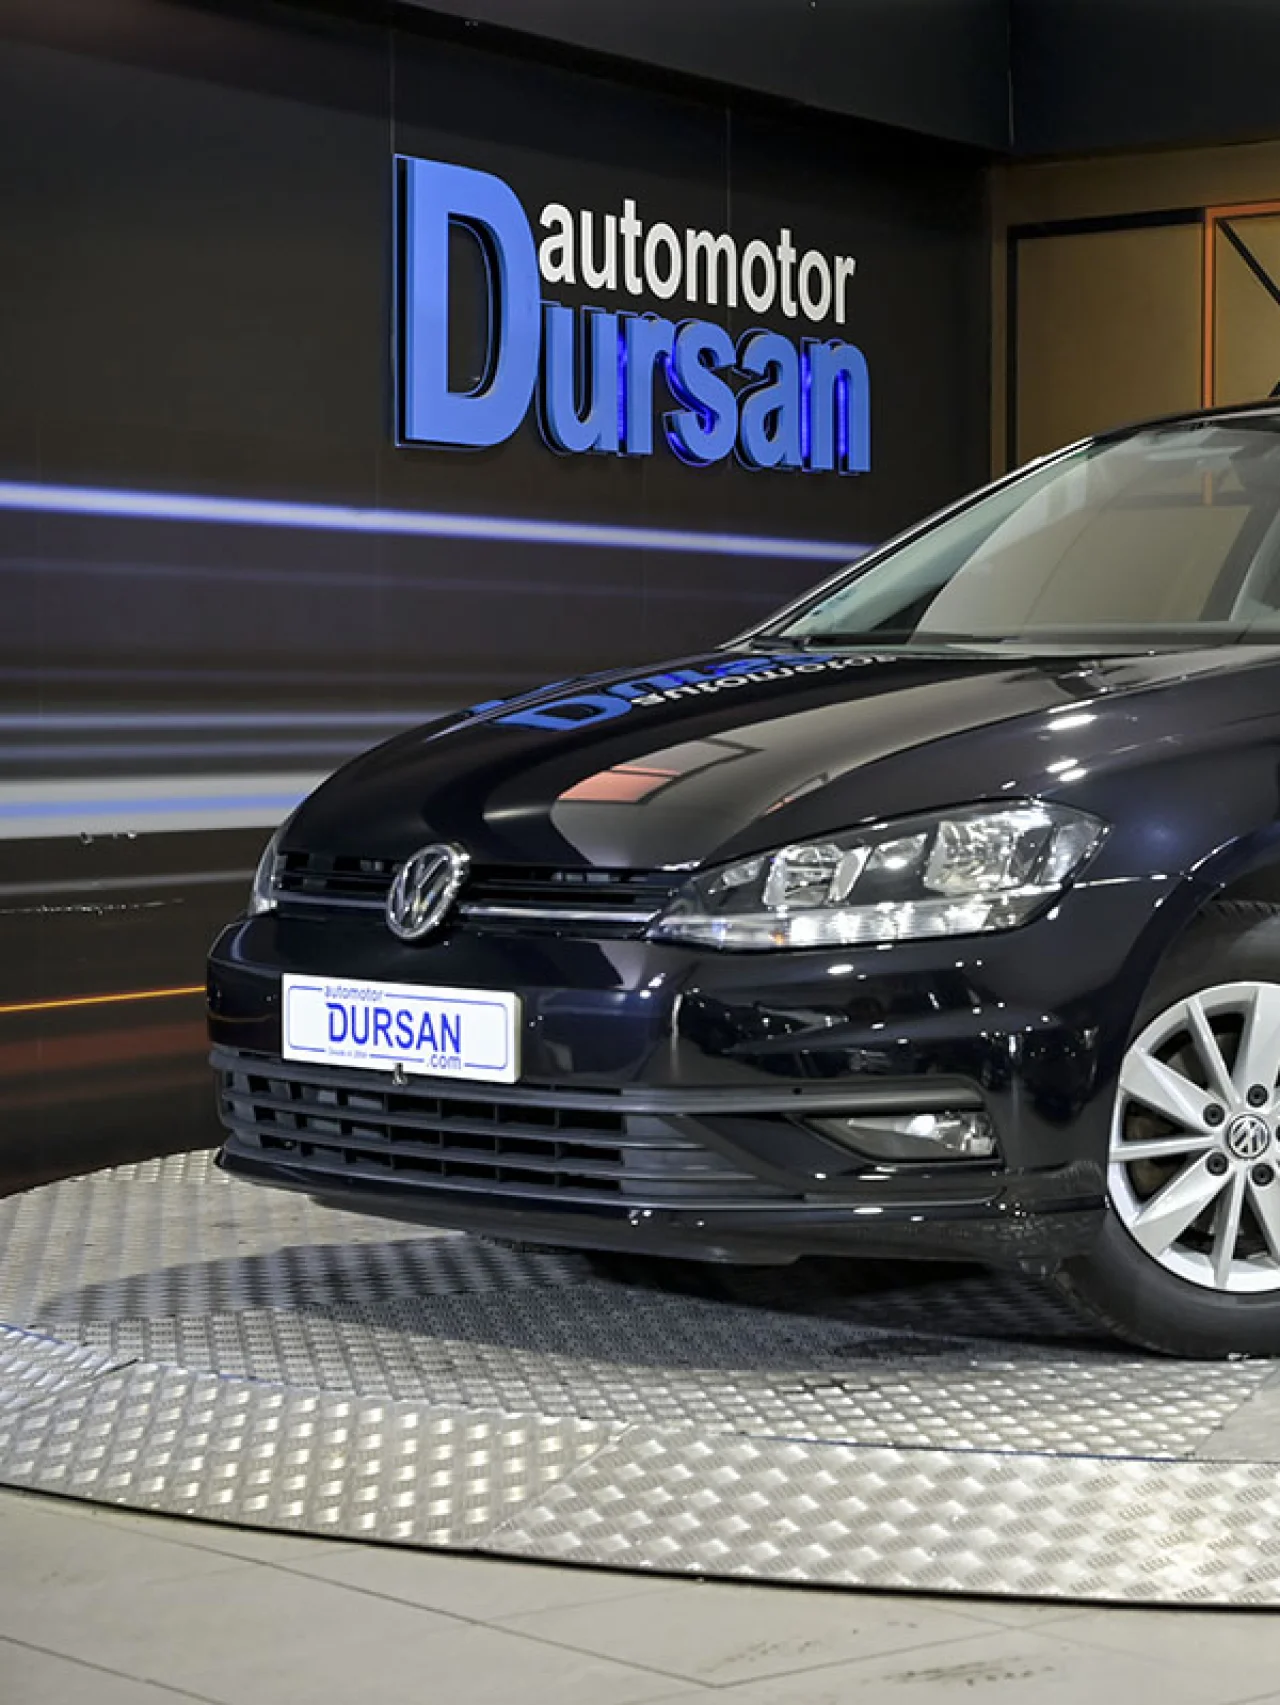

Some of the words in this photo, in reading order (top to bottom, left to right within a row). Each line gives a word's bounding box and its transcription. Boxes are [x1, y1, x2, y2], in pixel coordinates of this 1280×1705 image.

[539, 199, 856, 324] automotor
[395, 154, 872, 475] Dursan
[326, 1003, 461, 1053] DURSAN
[426, 1054, 461, 1070] .com
